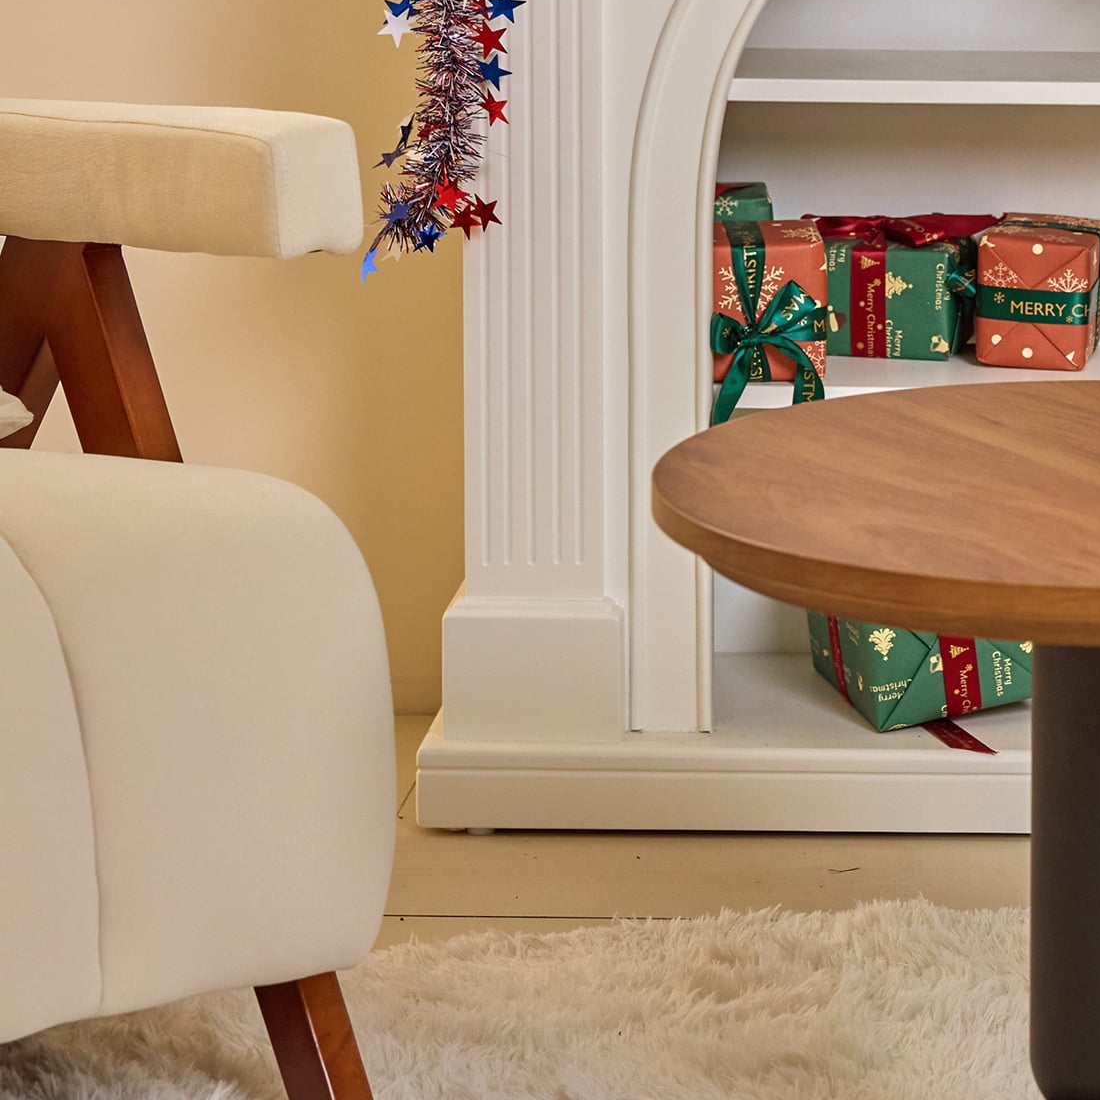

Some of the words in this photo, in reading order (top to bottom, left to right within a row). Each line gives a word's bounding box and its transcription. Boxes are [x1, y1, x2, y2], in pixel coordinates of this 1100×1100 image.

[864, 283, 876, 312] Merry
[935, 263, 945, 311] Christmas
[1010, 300, 1067, 317] MERRY
[892, 329, 903, 357] Merry
[959, 669, 969, 698] Merry
[991, 650, 1004, 697] Christmas
[1003, 657, 1013, 686] Merry
